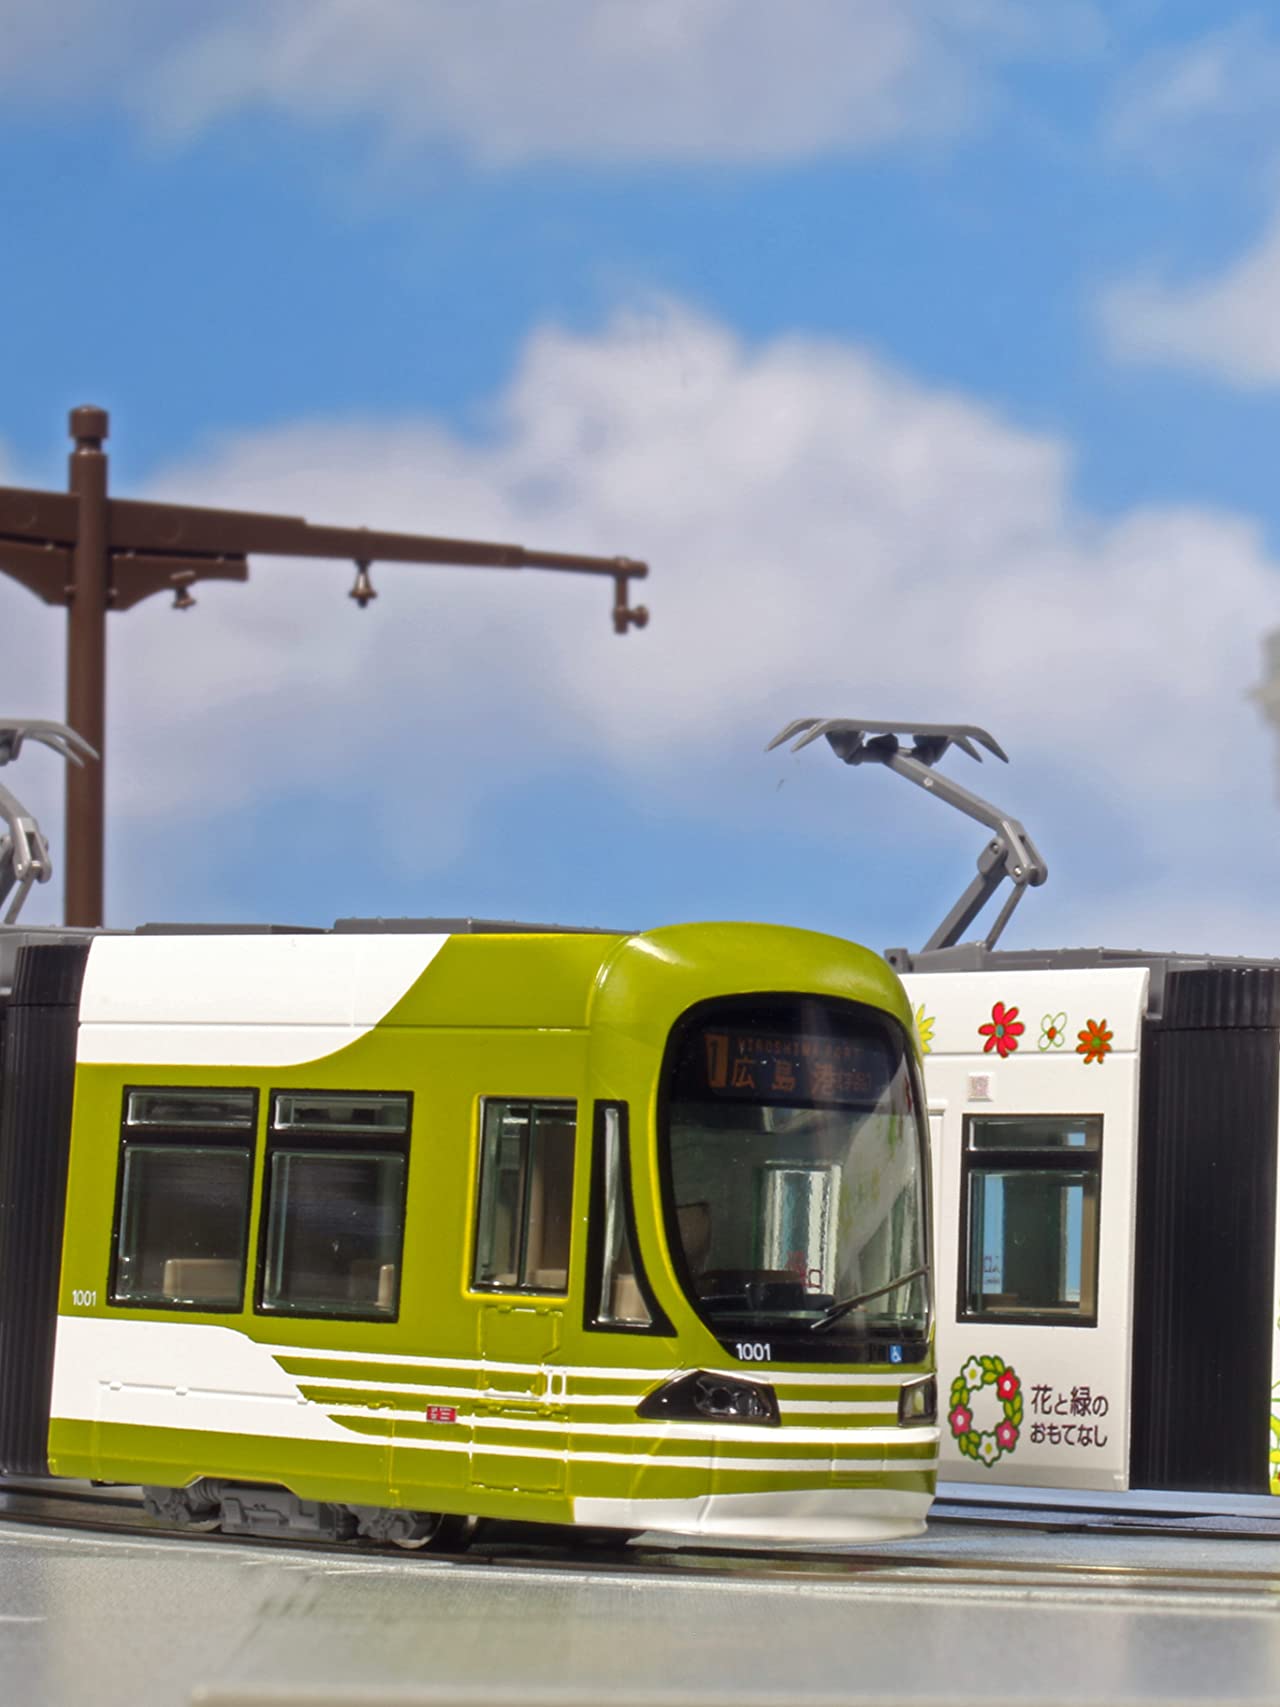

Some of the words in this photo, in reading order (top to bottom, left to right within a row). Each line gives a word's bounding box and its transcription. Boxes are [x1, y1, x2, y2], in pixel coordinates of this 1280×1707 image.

[72, 1288, 97, 1307] 1001
[736, 1343, 771, 1361] 1001
[1030, 1384, 1109, 1417] 花と緑の
[1030, 1422, 1108, 1448] おもてなし
